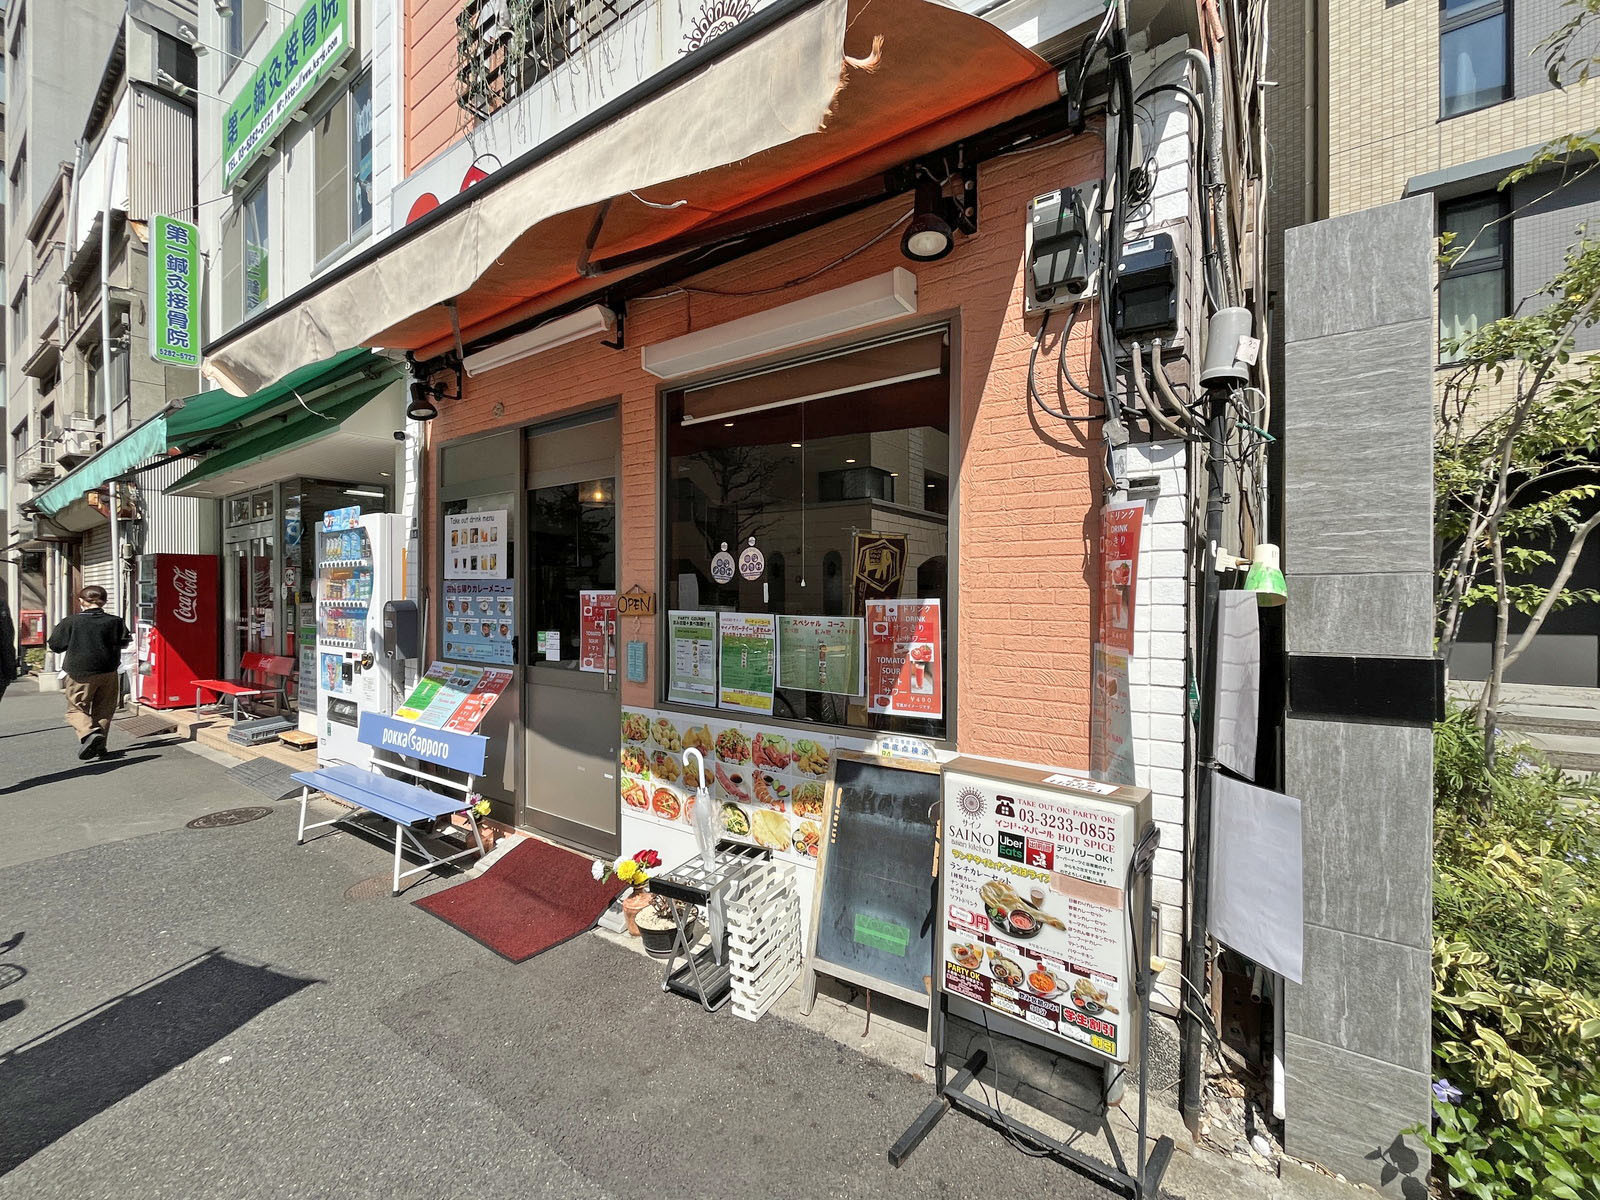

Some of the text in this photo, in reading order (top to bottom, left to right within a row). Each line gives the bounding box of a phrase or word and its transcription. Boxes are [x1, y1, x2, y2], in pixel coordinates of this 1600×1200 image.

[167, 224, 188, 347] 第一鍼灸接骨院
[173, 566, 198, 623] Coca-Cola
[618, 596, 651, 613] OPEN
[893, 624, 924, 632] すっきり
[877, 657, 906, 665] TOMATO
[882, 678, 902, 686] トマト
[883, 688, 907, 696] サワー
[1018, 799, 1116, 824] TAKE OUT OK! PARTY OK!
[962, 819, 981, 829] サイノ
[1019, 808, 1116, 842] 03-3233-0855
[949, 825, 994, 847] SAINO
[999, 835, 1023, 848] Uber
[1058, 833, 1080, 845] HOT
[1083, 839, 1116, 853] SPICE
[999, 846, 1023, 858] Eats
[1057, 844, 1113, 864] デリバリーOK!
[950, 862, 1012, 885] ランチカレーセット
[947, 962, 980, 981] PARTY OK
[1063, 1008, 1115, 1038] 学生割引
[1090, 1034, 1116, 1055] 割引
